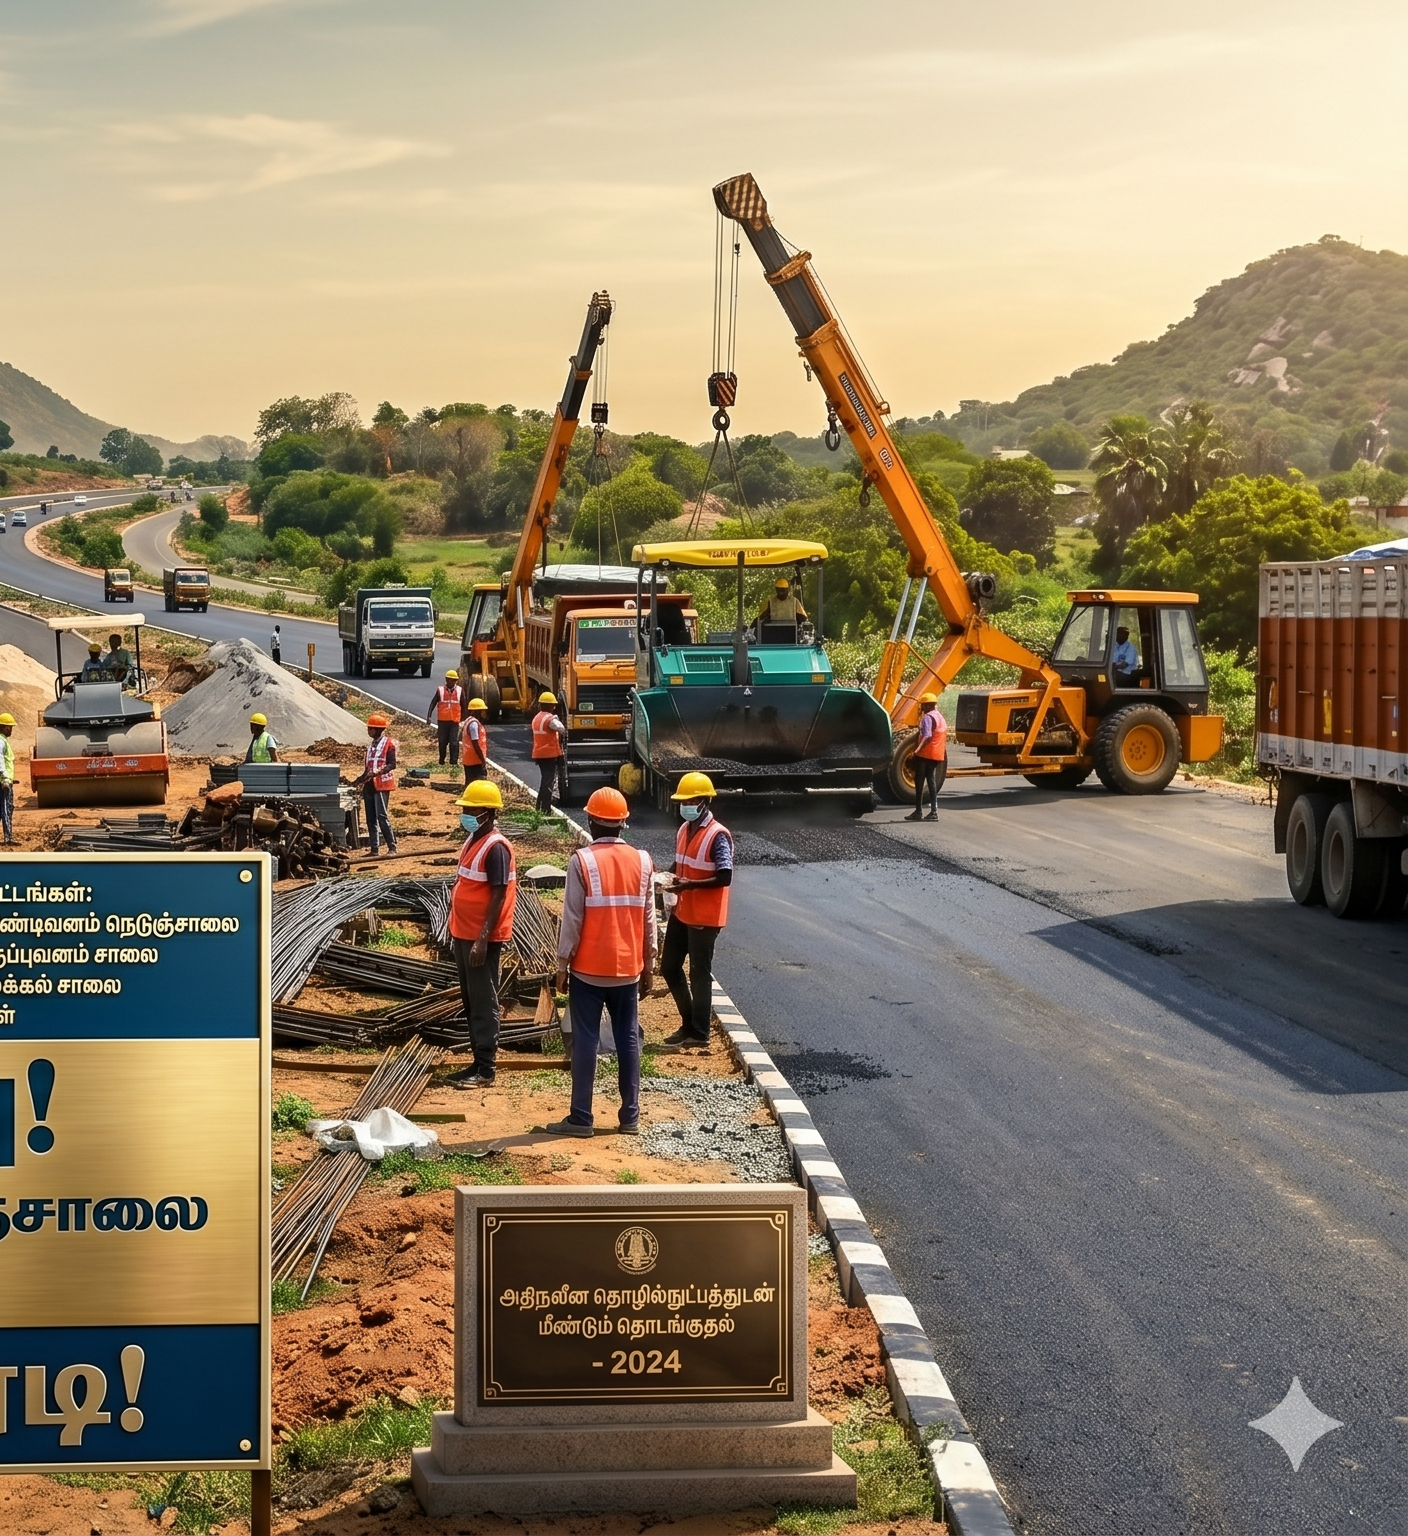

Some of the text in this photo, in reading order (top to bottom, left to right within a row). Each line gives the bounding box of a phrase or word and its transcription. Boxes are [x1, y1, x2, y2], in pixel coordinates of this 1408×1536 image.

[105, 911, 240, 938] நெடுஞ்சாலை
[94, 948, 159, 963] சாலை
[57, 978, 122, 994] சாலை
[593, 1281, 776, 1311] தொழில்நுட்பத்துடன்
[538, 1312, 735, 1341] மீண்டும் தொடங்குதல்
[610, 1349, 682, 1375] 2024
